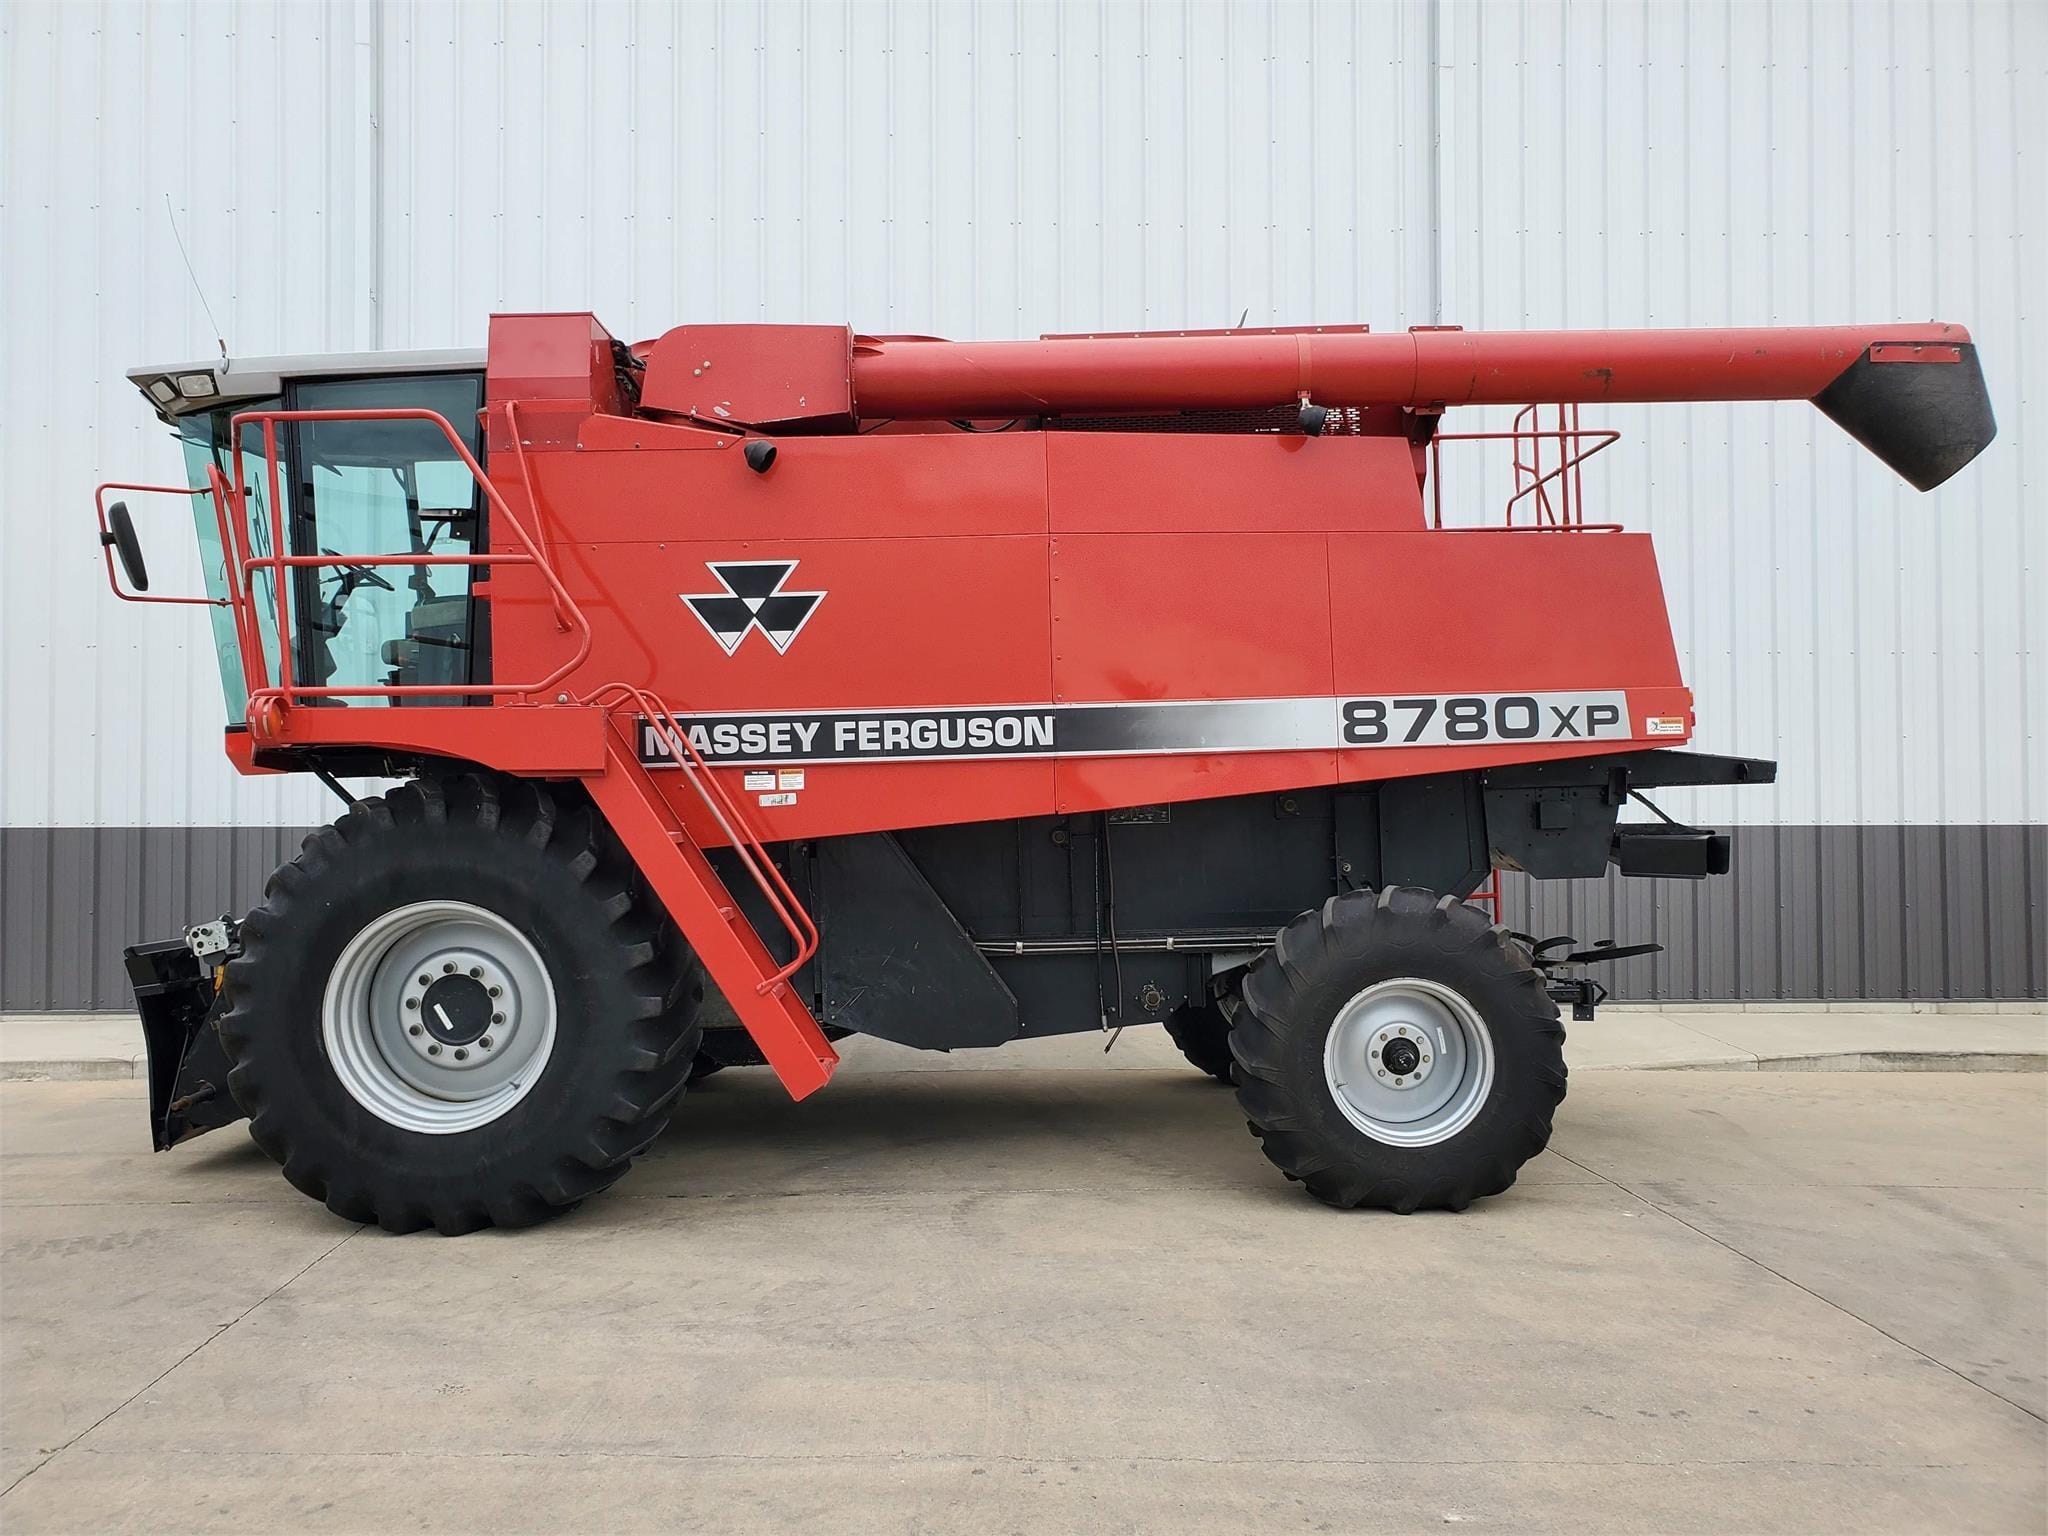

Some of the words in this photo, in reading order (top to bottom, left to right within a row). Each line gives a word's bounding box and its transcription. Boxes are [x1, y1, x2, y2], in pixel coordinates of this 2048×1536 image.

[644, 722, 821, 757] MASSEY
[834, 715, 1055, 751] FERGUSON
[1342, 696, 1540, 744] 8780
[1549, 704, 1620, 738] XP
